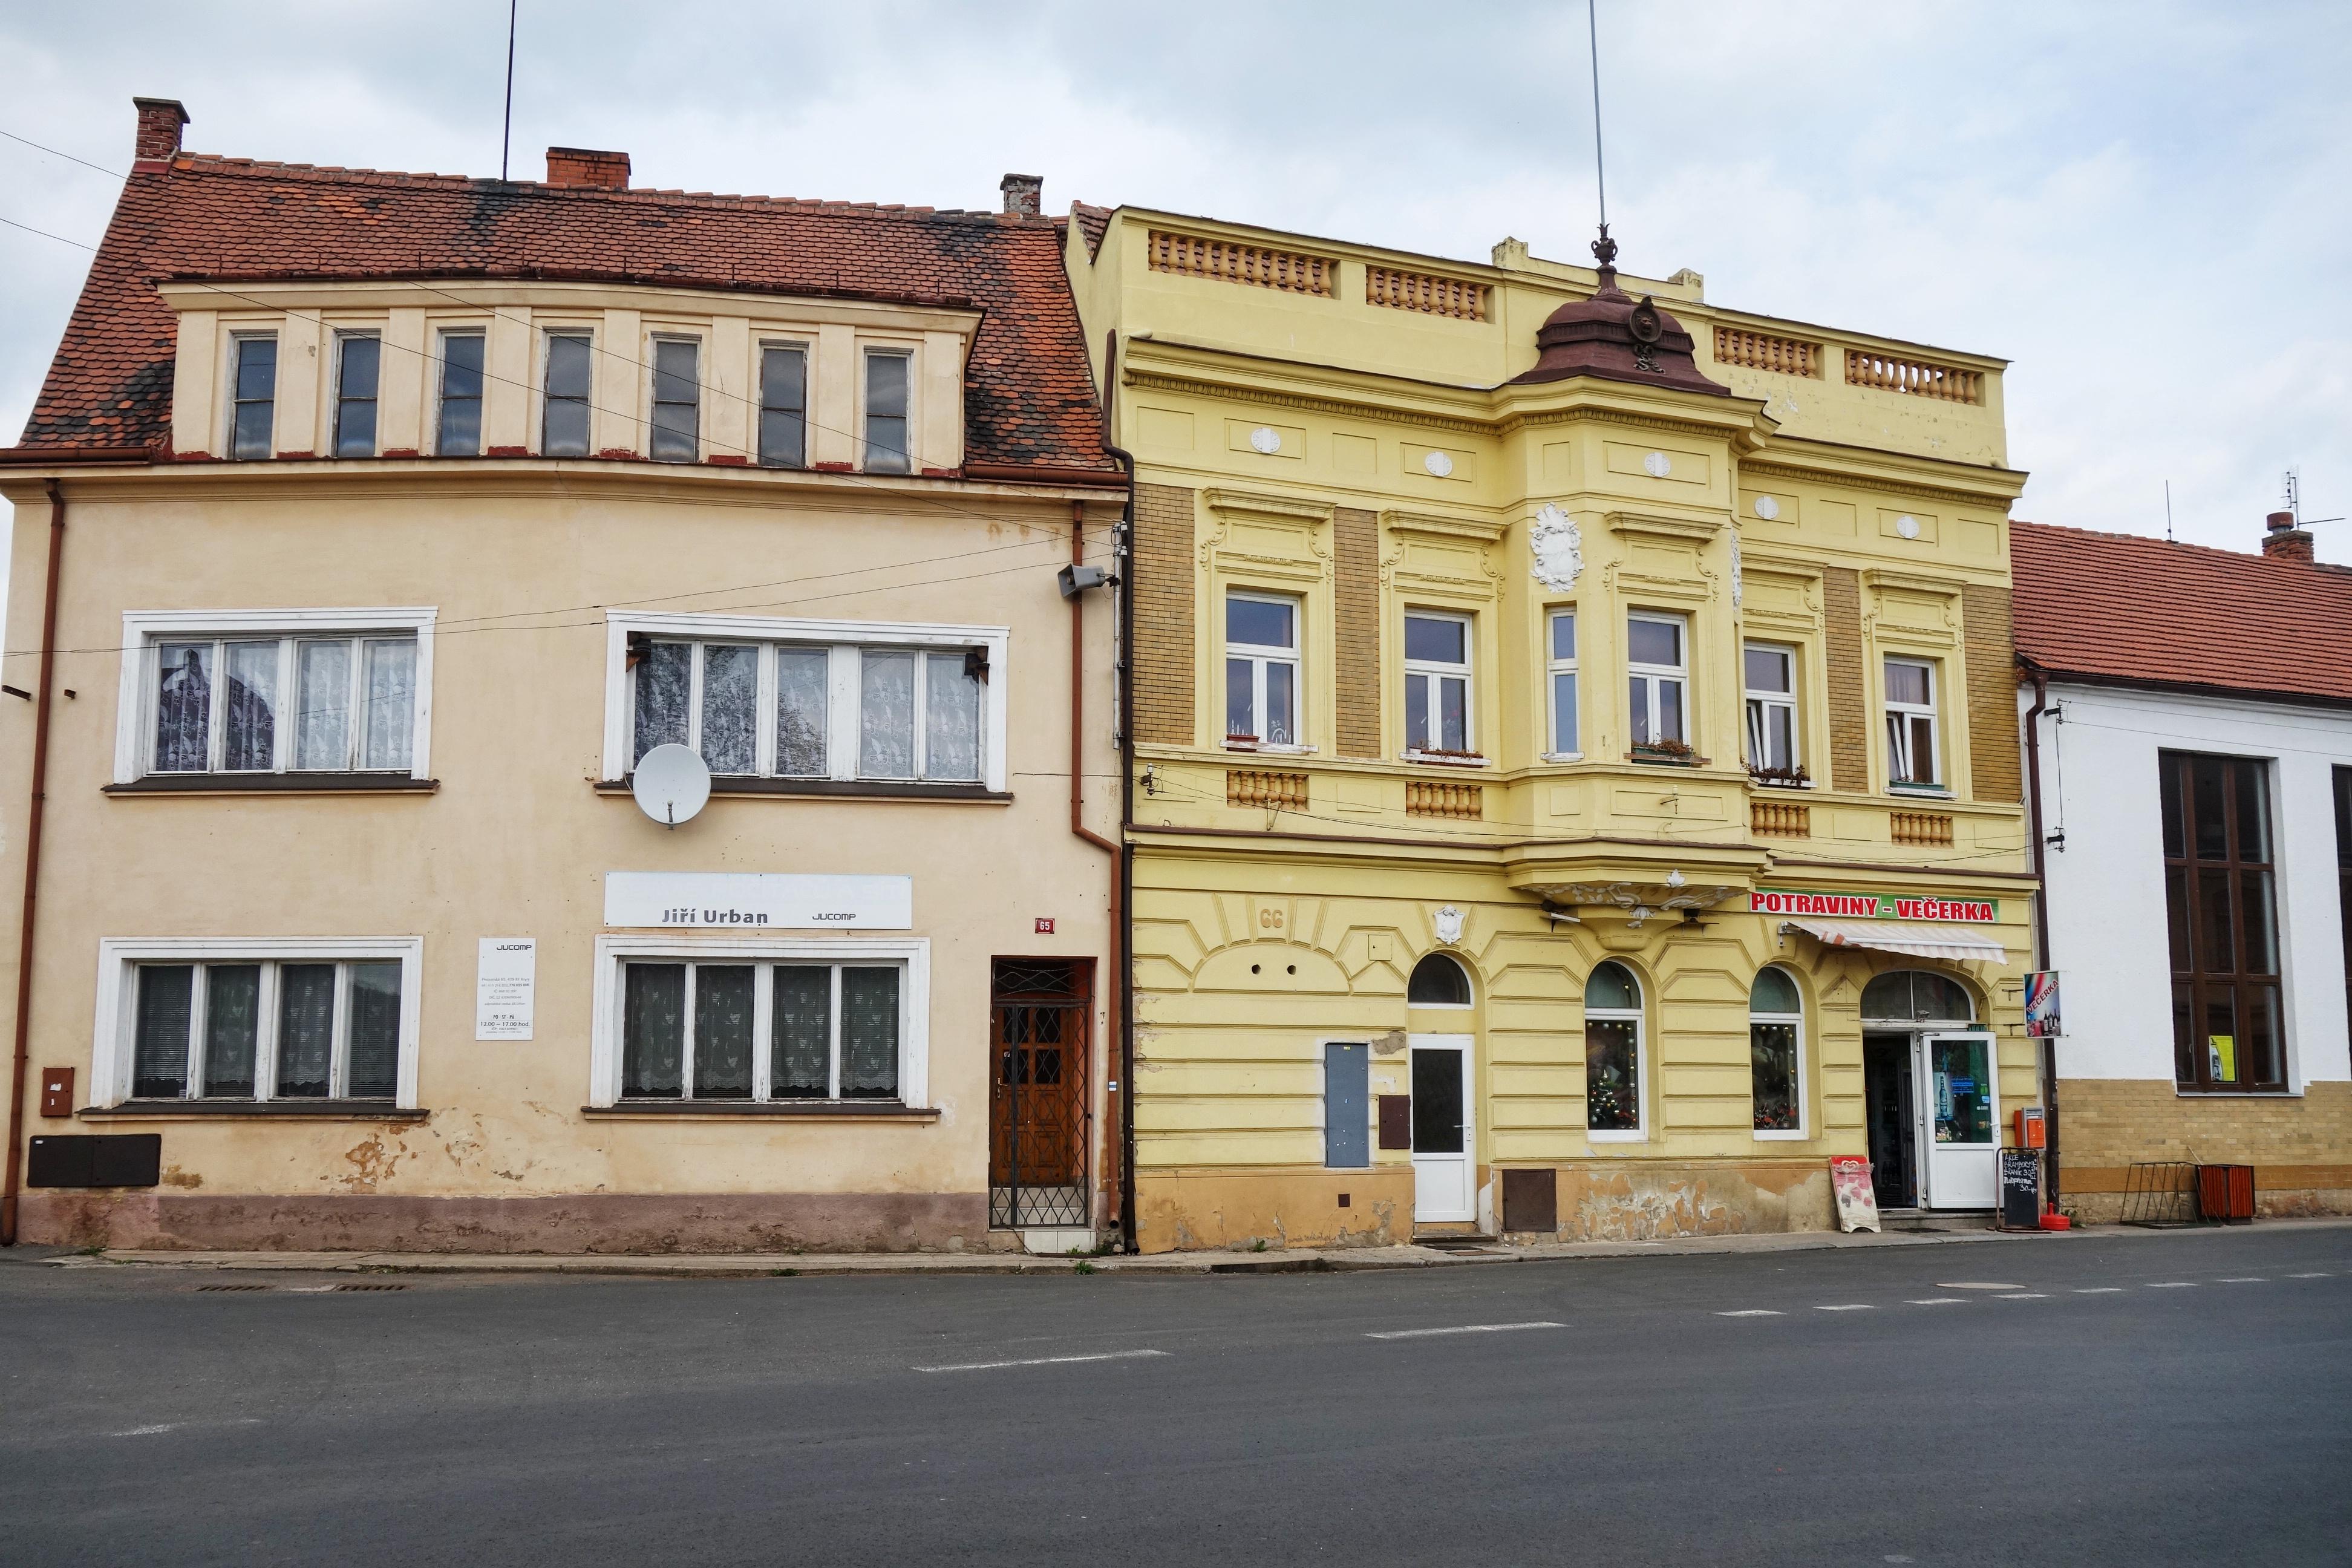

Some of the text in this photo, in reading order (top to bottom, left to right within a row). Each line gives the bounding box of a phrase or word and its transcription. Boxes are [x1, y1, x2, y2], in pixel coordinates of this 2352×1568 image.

[662, 908, 768, 923] Jiří Urban
[1751, 892, 1878, 916] POTRAVINY
[1895, 897, 1994, 921] VEČERKA
[1040, 921, 1050, 930] 65
[1260, 909, 1283, 928] 66
[2026, 979, 2059, 1014] VEČERKA
